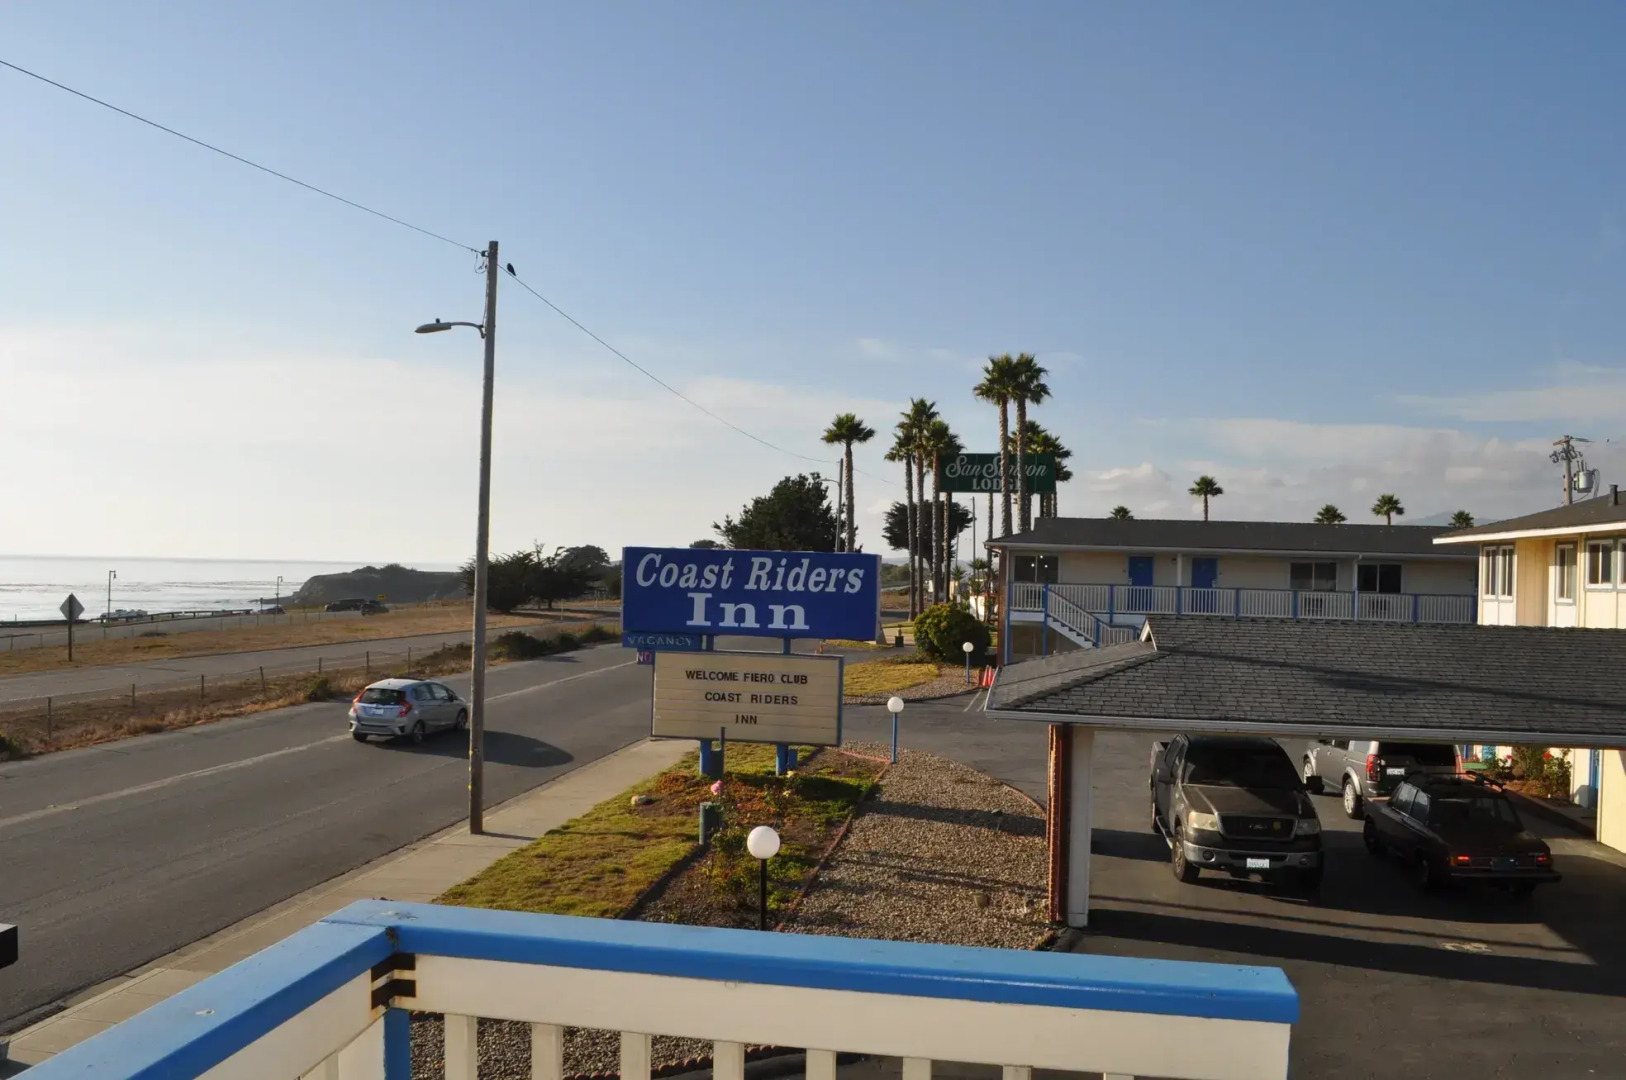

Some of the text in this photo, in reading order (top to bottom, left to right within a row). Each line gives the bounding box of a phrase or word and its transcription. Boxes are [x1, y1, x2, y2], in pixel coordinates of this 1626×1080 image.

[945, 455, 1048, 478] San Smon
[635, 553, 865, 594] Coast Riders
[686, 592, 810, 630] Inn
[627, 635, 692, 646] VACANCY
[636, 650, 651, 663] NO
[685, 670, 808, 685] WELCOME FIERO CLUB
[704, 691, 798, 705] COAST RIDERS
[735, 714, 758, 725] INN
